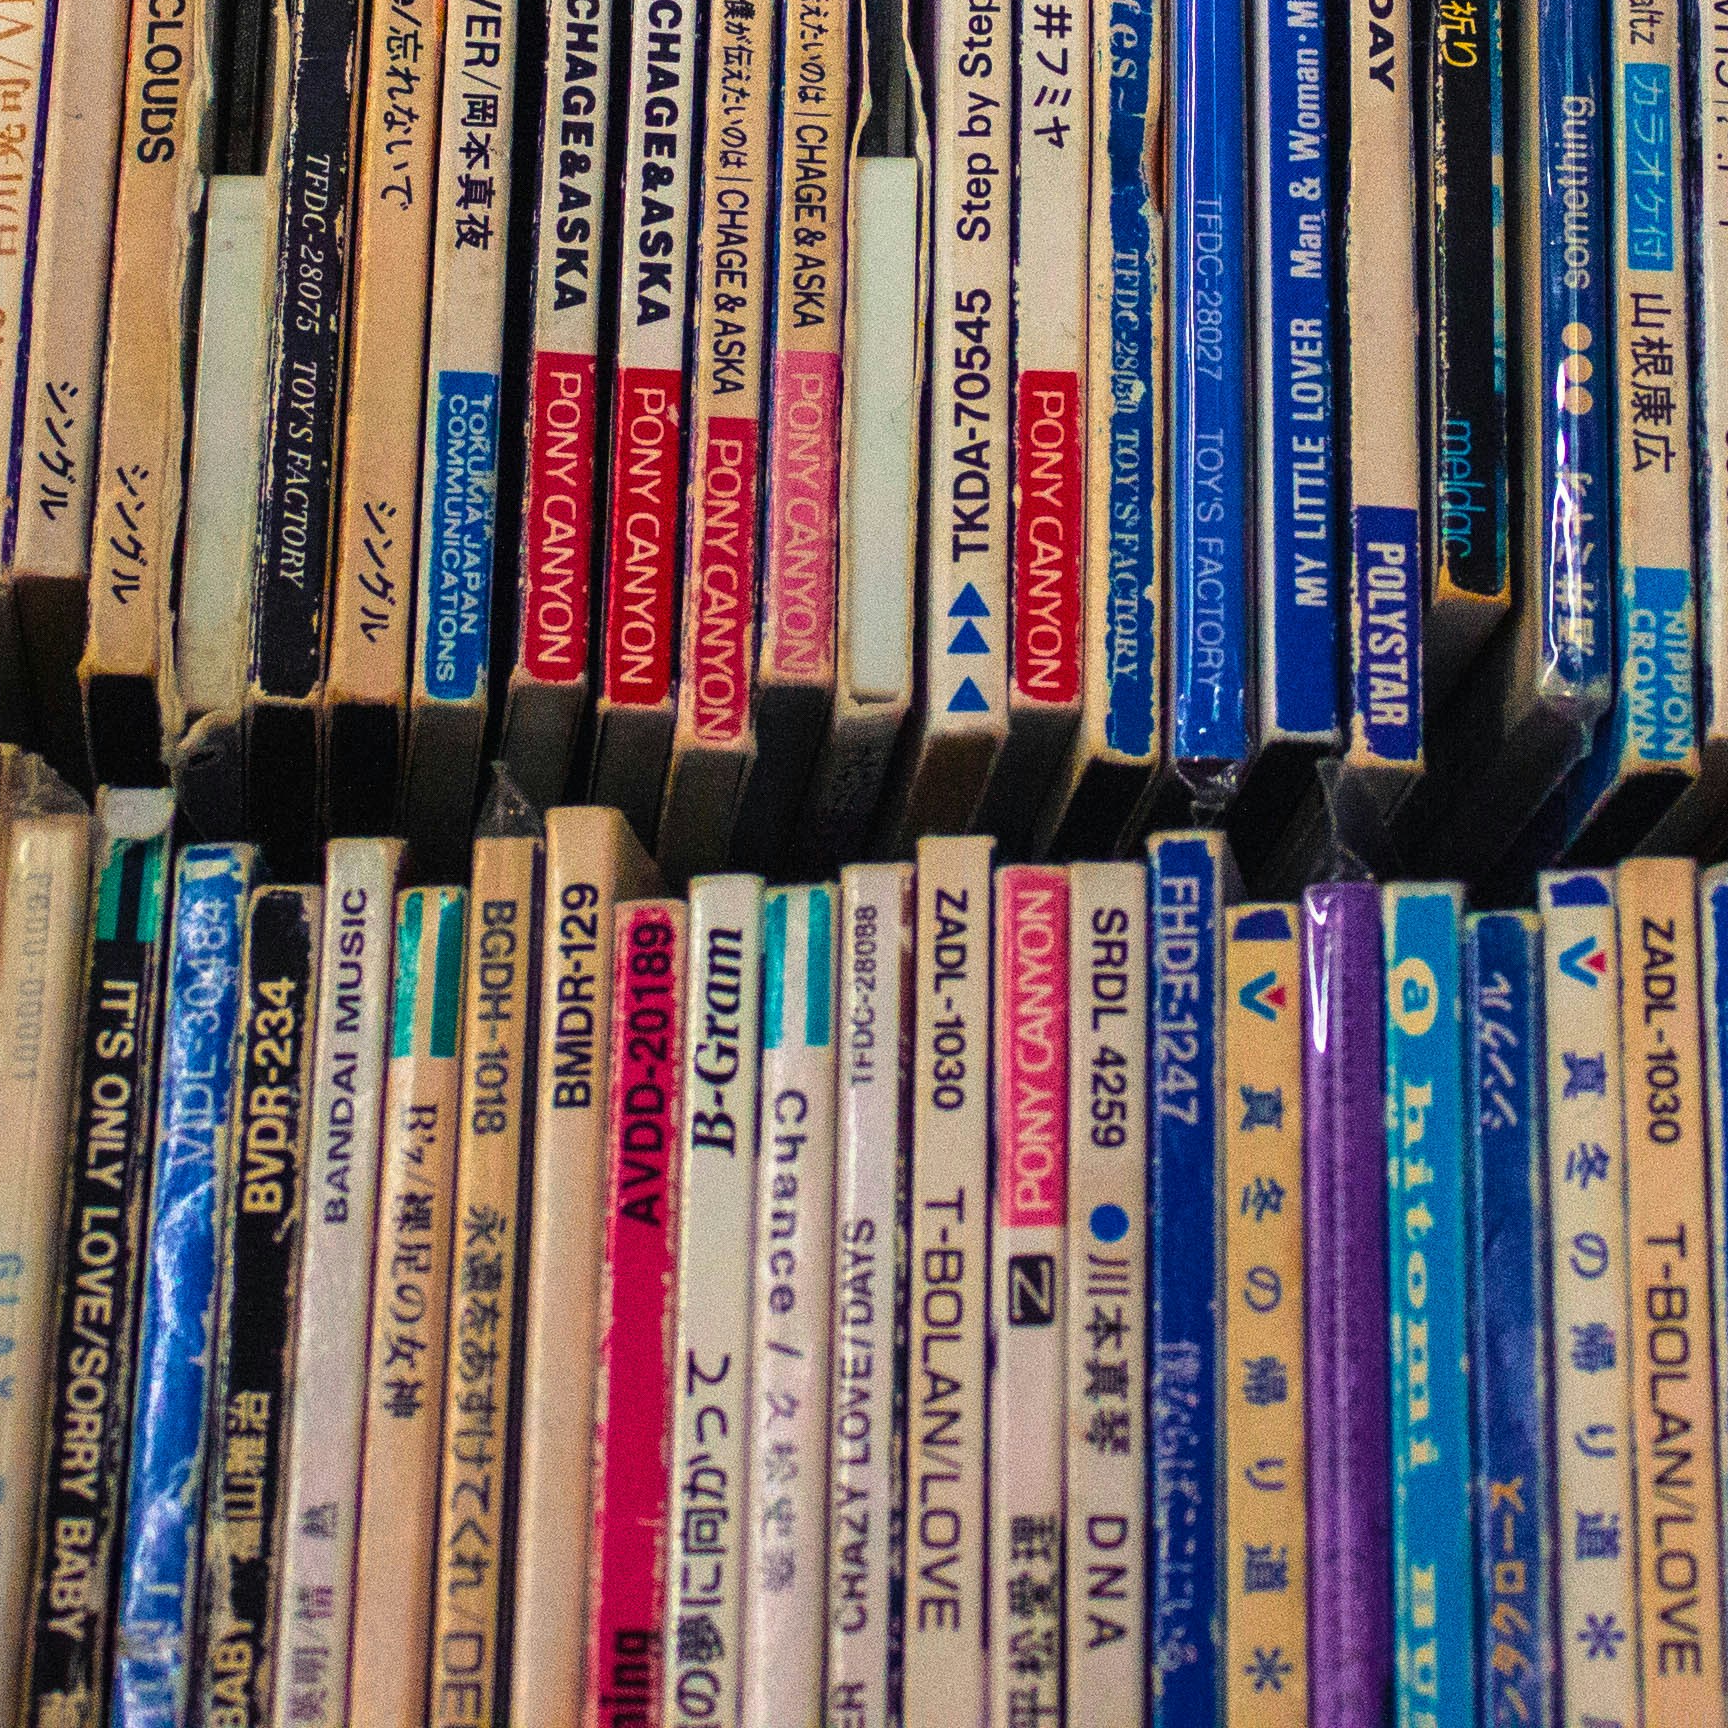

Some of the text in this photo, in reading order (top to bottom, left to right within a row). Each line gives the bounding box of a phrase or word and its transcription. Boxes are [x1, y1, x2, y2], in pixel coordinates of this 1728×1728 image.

[1562, 94, 1594, 291] something
[40, 380, 81, 521] シングル
[949, 288, 990, 563] TKDA-70545
[114, 463, 151, 605] シングル
[1363, 541, 1405, 728] POLYSTAR
[472, 897, 516, 1136] BGDH-1018
[553, 883, 598, 1108] BMDR-129
[622, 919, 671, 1226] AVDD-20189
[690, 927, 743, 1157] B-Gram
[1017, 888, 1054, 1074] CANYON
[1092, 908, 1127, 1028] SRDL
[243, 977, 295, 1214] BVDR-234
[323, 1098, 359, 1224] BANDAI
[1092, 1045, 1125, 1151] 4259
[919, 888, 967, 1633] ZADL-1030 T-BOLAN/LOVE
[1639, 918, 1700, 1678] ZADL-1030 T-BOLAN/LOVE
